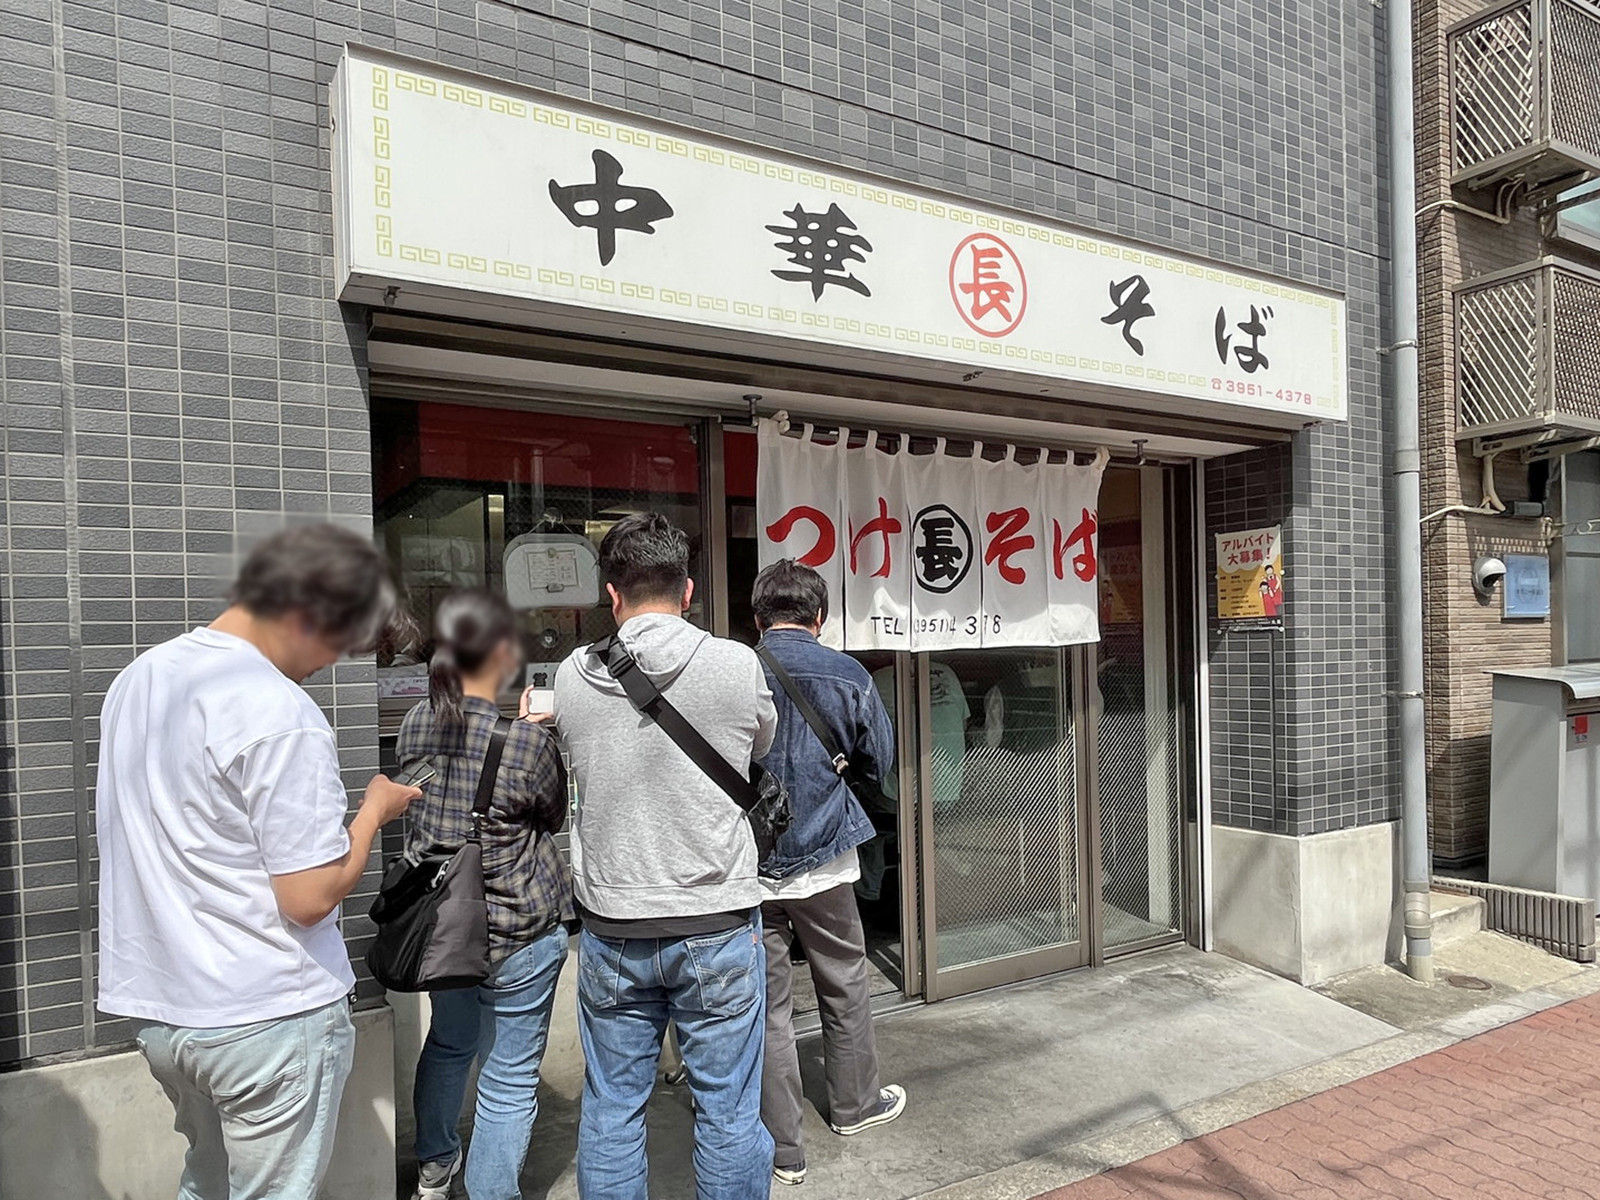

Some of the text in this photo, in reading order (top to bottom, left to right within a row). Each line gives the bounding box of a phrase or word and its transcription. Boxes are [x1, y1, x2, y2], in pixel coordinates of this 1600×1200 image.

[1100, 274, 1275, 373] そば
[1226, 380, 1312, 405] 3951-4378
[765, 496, 902, 579] つけ
[1221, 532, 1274, 553] アルバイト
[1227, 547, 1271, 566] 大募集!
[870, 616, 904, 636] TEL
